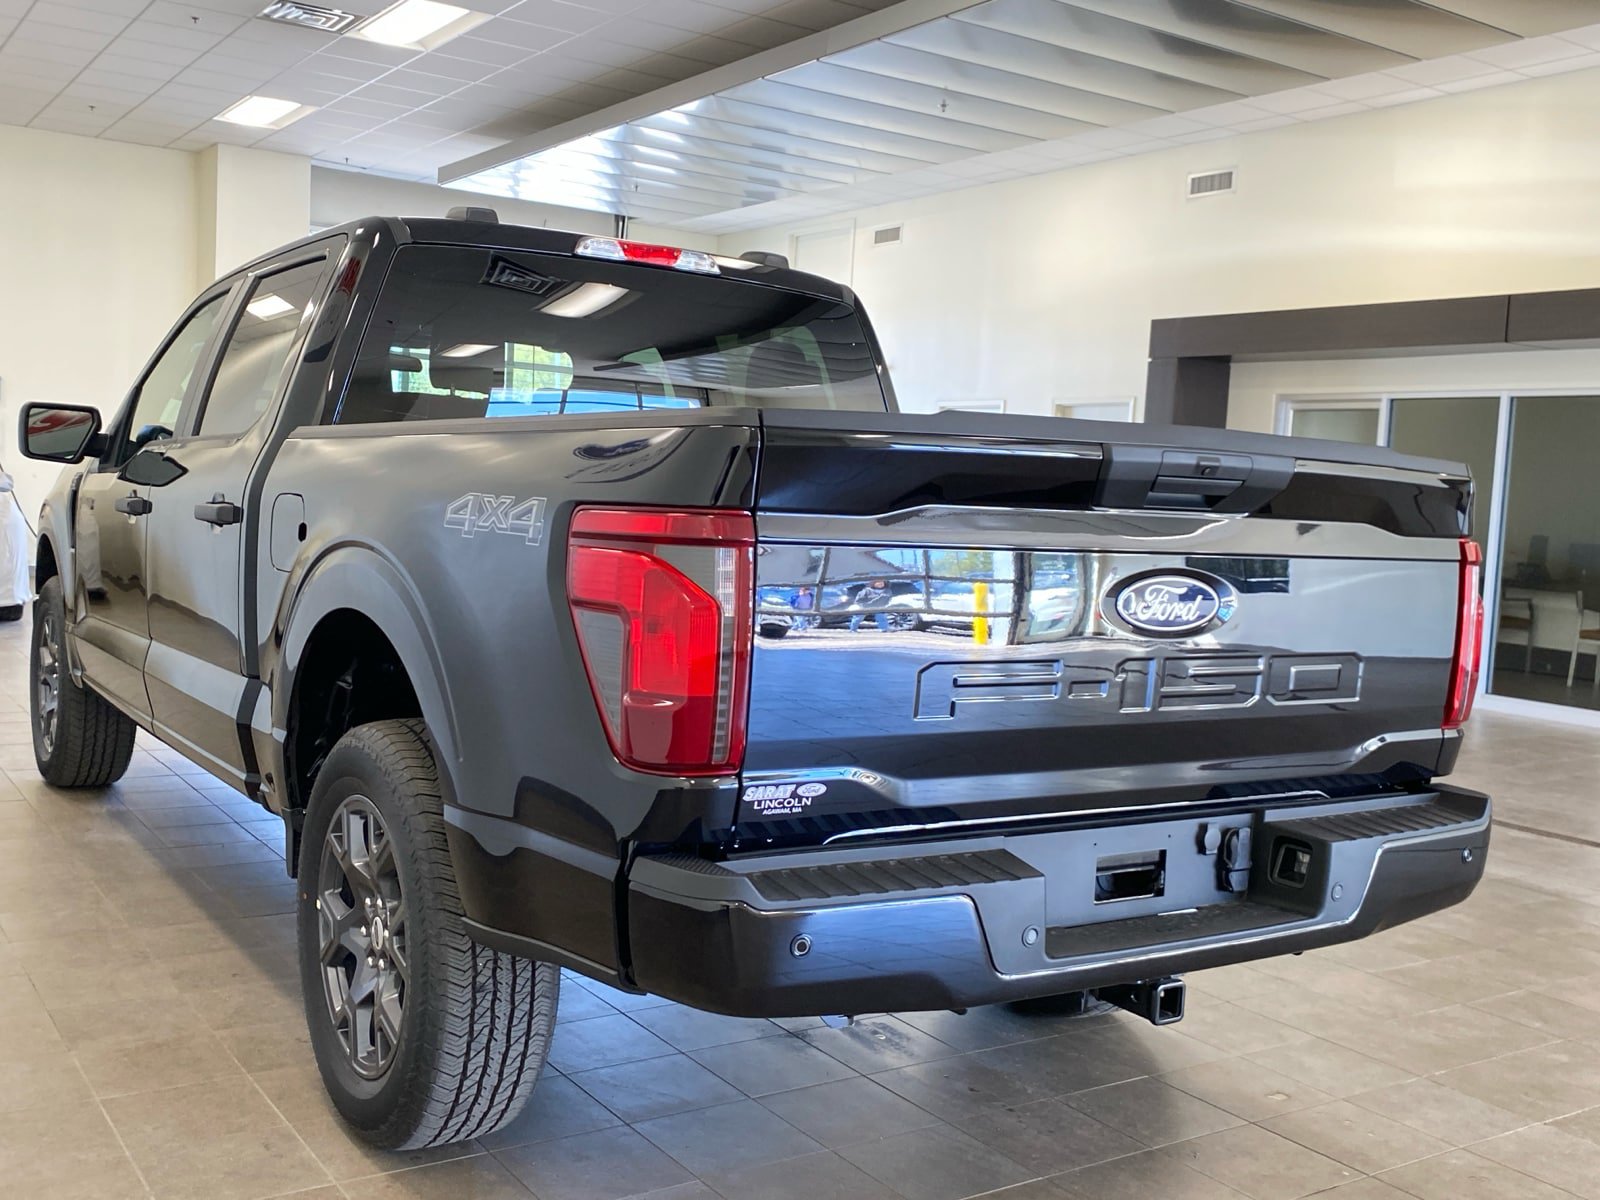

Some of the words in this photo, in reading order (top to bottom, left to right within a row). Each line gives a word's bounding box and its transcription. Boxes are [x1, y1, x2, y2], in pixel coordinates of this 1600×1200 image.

[444, 492, 547, 547] 4X4
[1120, 584, 1204, 622] Ford
[912, 651, 1364, 721] F-150
[742, 784, 797, 801] SARAT
[753, 797, 812, 810] LINCOLN
